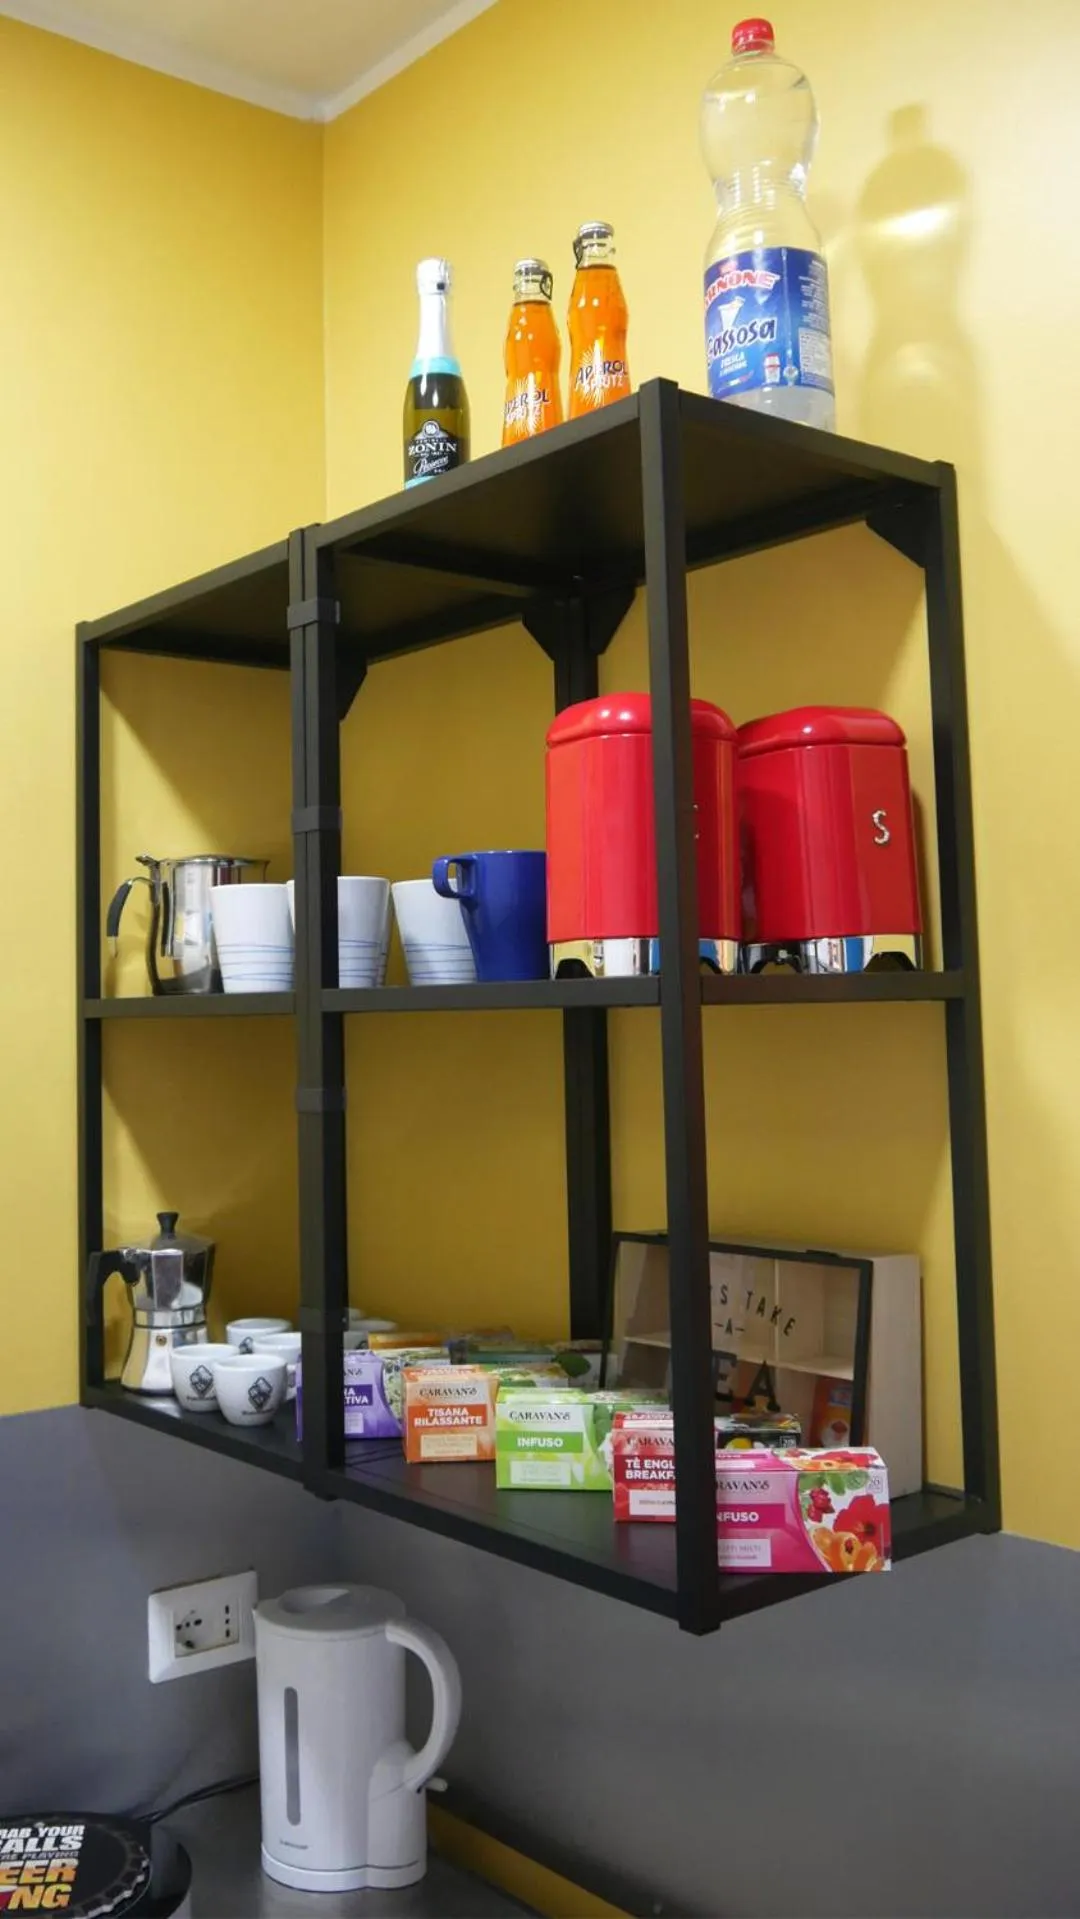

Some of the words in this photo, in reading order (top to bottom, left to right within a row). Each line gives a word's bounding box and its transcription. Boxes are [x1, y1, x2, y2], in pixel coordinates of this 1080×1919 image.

[408, 442, 457, 456] ZONIN
[872, 809, 890, 844] S
[746, 1291, 796, 1336] TAKE
[427, 1407, 469, 1417] TISANA
[414, 1415, 483, 1427] RILASSANTE
[517, 1437, 563, 1447] INFUSO
[625, 1470, 675, 1480] BREAKF
[38, 1825, 85, 1837] YOUR
[0, 1836, 84, 1853] ALLS
